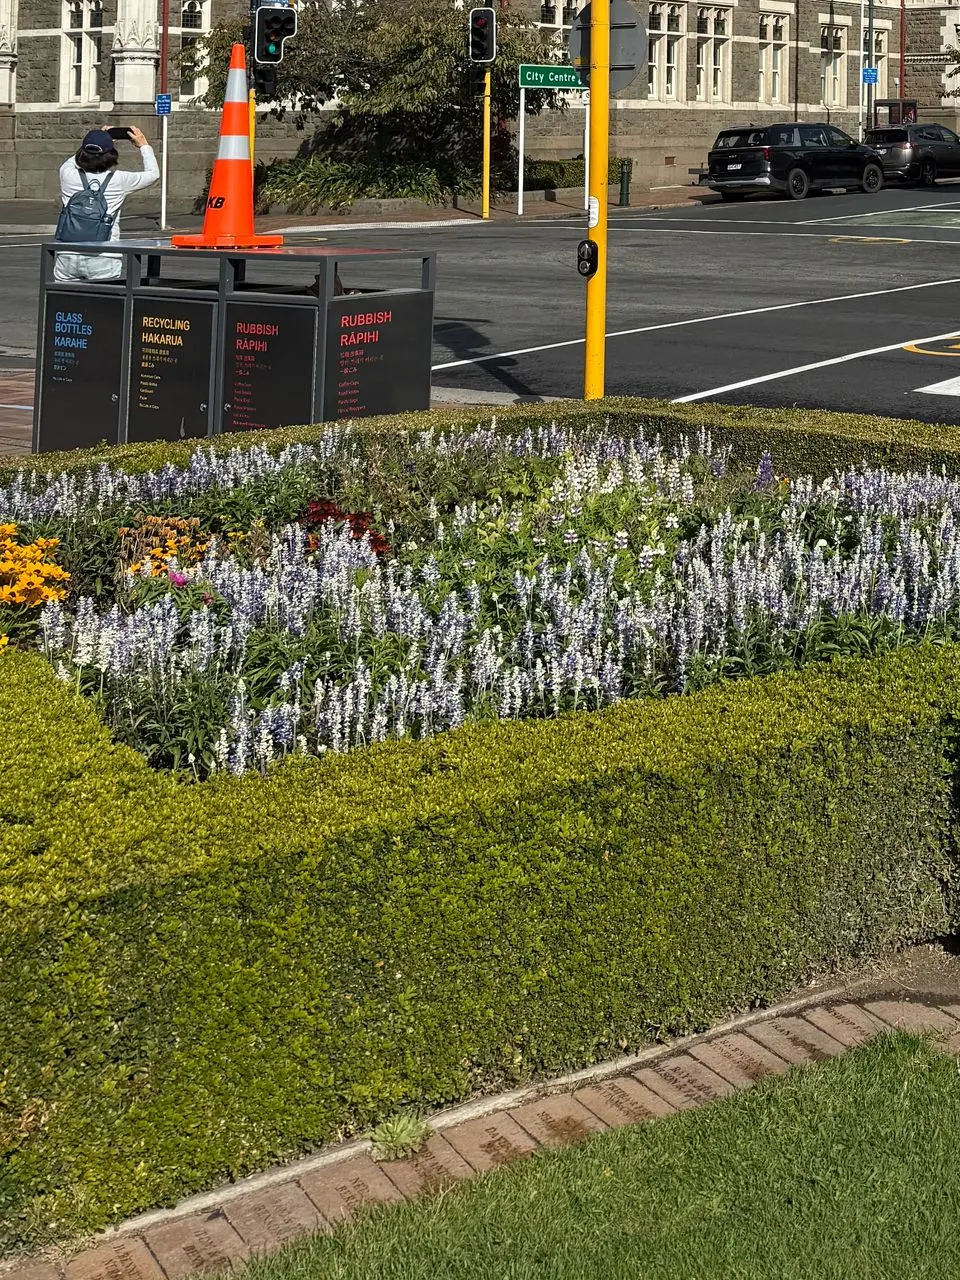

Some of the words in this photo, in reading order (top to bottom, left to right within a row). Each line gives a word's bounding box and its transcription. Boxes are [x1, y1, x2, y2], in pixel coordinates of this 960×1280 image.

[526, 71, 544, 83] City
[548, 72, 576, 82] Centre
[55, 311, 83, 324] GLASS
[142, 316, 191, 331] RECYCLING
[341, 310, 392, 328] RUBBISH
[55, 322, 93, 336] BOTTLES
[236, 322, 279, 336] RUBBISH
[54, 336, 88, 349] KARAHE
[142, 332, 183, 347] HAKARUA
